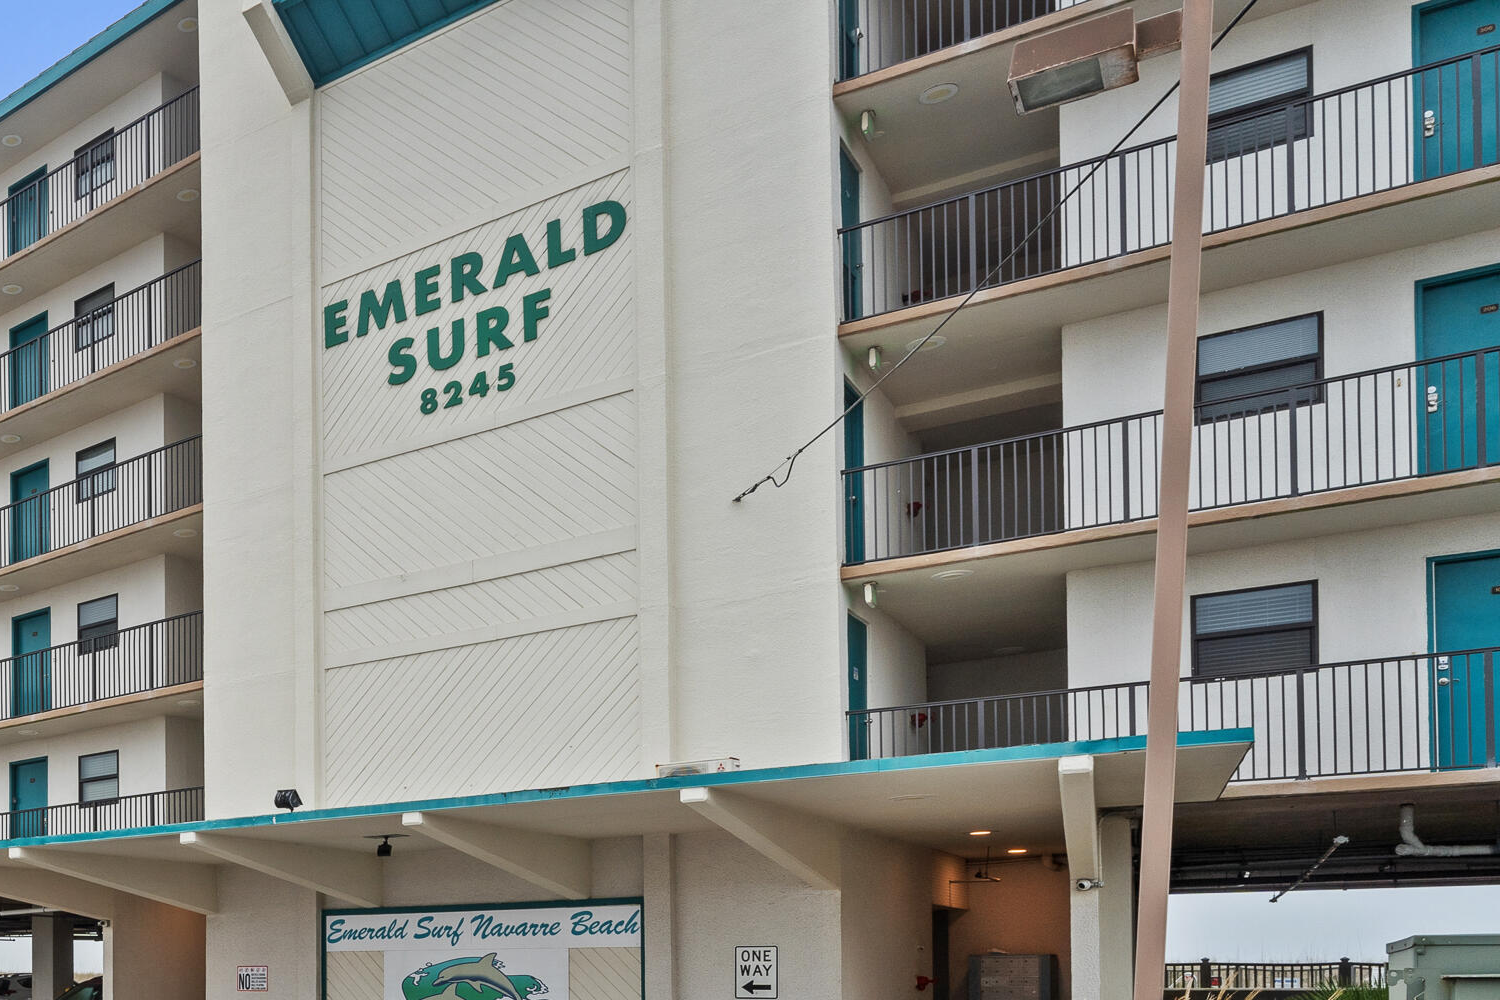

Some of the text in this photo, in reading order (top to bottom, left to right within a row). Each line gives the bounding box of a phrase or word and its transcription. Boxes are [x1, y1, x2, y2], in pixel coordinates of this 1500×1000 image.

[324, 200, 627, 349] EMERALD
[387, 287, 551, 386] SURF
[420, 362, 516, 415] 8245
[327, 909, 640, 947] Emerald Surf Navarre Beach
[740, 964, 772, 976] WAY
[741, 950, 772, 962] ONE
[238, 973, 251, 990] NO
